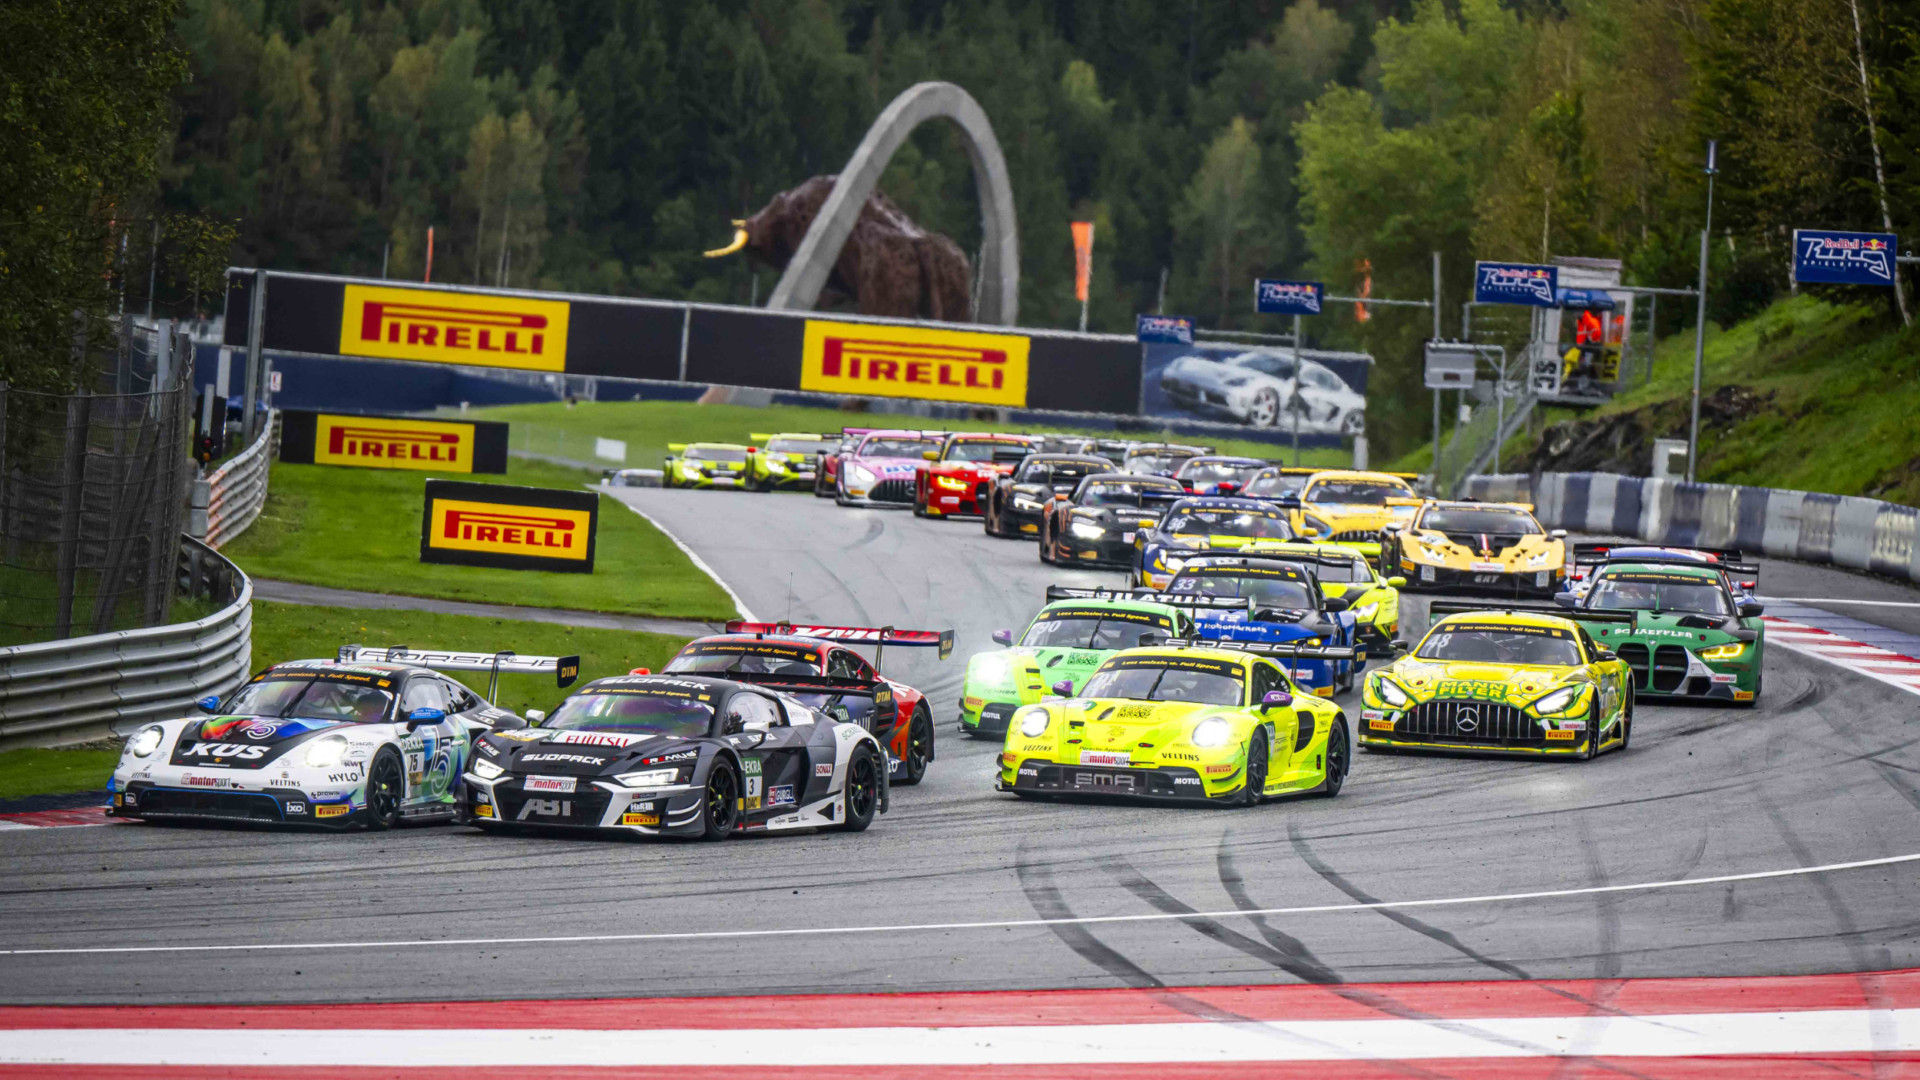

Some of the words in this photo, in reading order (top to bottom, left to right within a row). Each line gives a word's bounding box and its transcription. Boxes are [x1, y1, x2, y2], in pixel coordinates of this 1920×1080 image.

[361, 301, 548, 355] PIRELLI
[822, 335, 1008, 390] PIRELLI
[329, 426, 460, 462] PIRELLI
[444, 509, 576, 549] PIRELLI
[1173, 578, 1196, 591] 33
[1204, 623, 1268, 633] RoboMarkets
[1426, 633, 1453, 649] 48
[562, 666, 577, 679] DTM
[1439, 686, 1502, 698] FILTER
[1440, 681, 1507, 691] MANN
[875, 690, 891, 703] DTM
[982, 711, 1001, 719] MOTUL
[1547, 731, 1573, 739] PIRELLI
[403, 736, 424, 750] DEKRA
[182, 743, 272, 760] KÜS
[649, 749, 697, 764] REMUS
[1162, 753, 1200, 761] VELTINS
[409, 754, 418, 772] 75
[745, 760, 761, 773] EKRA
[816, 765, 832, 774] SONAX
[1206, 764, 1232, 774] PIRELLI
[328, 772, 358, 782] HYLO
[1019, 768, 1037, 776] MOTUL
[270, 779, 301, 787] VELTINS
[1076, 772, 1136, 787] EMA
[1174, 777, 1200, 785] MOTUL
[748, 778, 755, 795] 3
[776, 789, 794, 800] GURGL
[286, 801, 303, 812] ixo
[319, 806, 347, 815] PIRELLI
[517, 799, 572, 820] ABT
